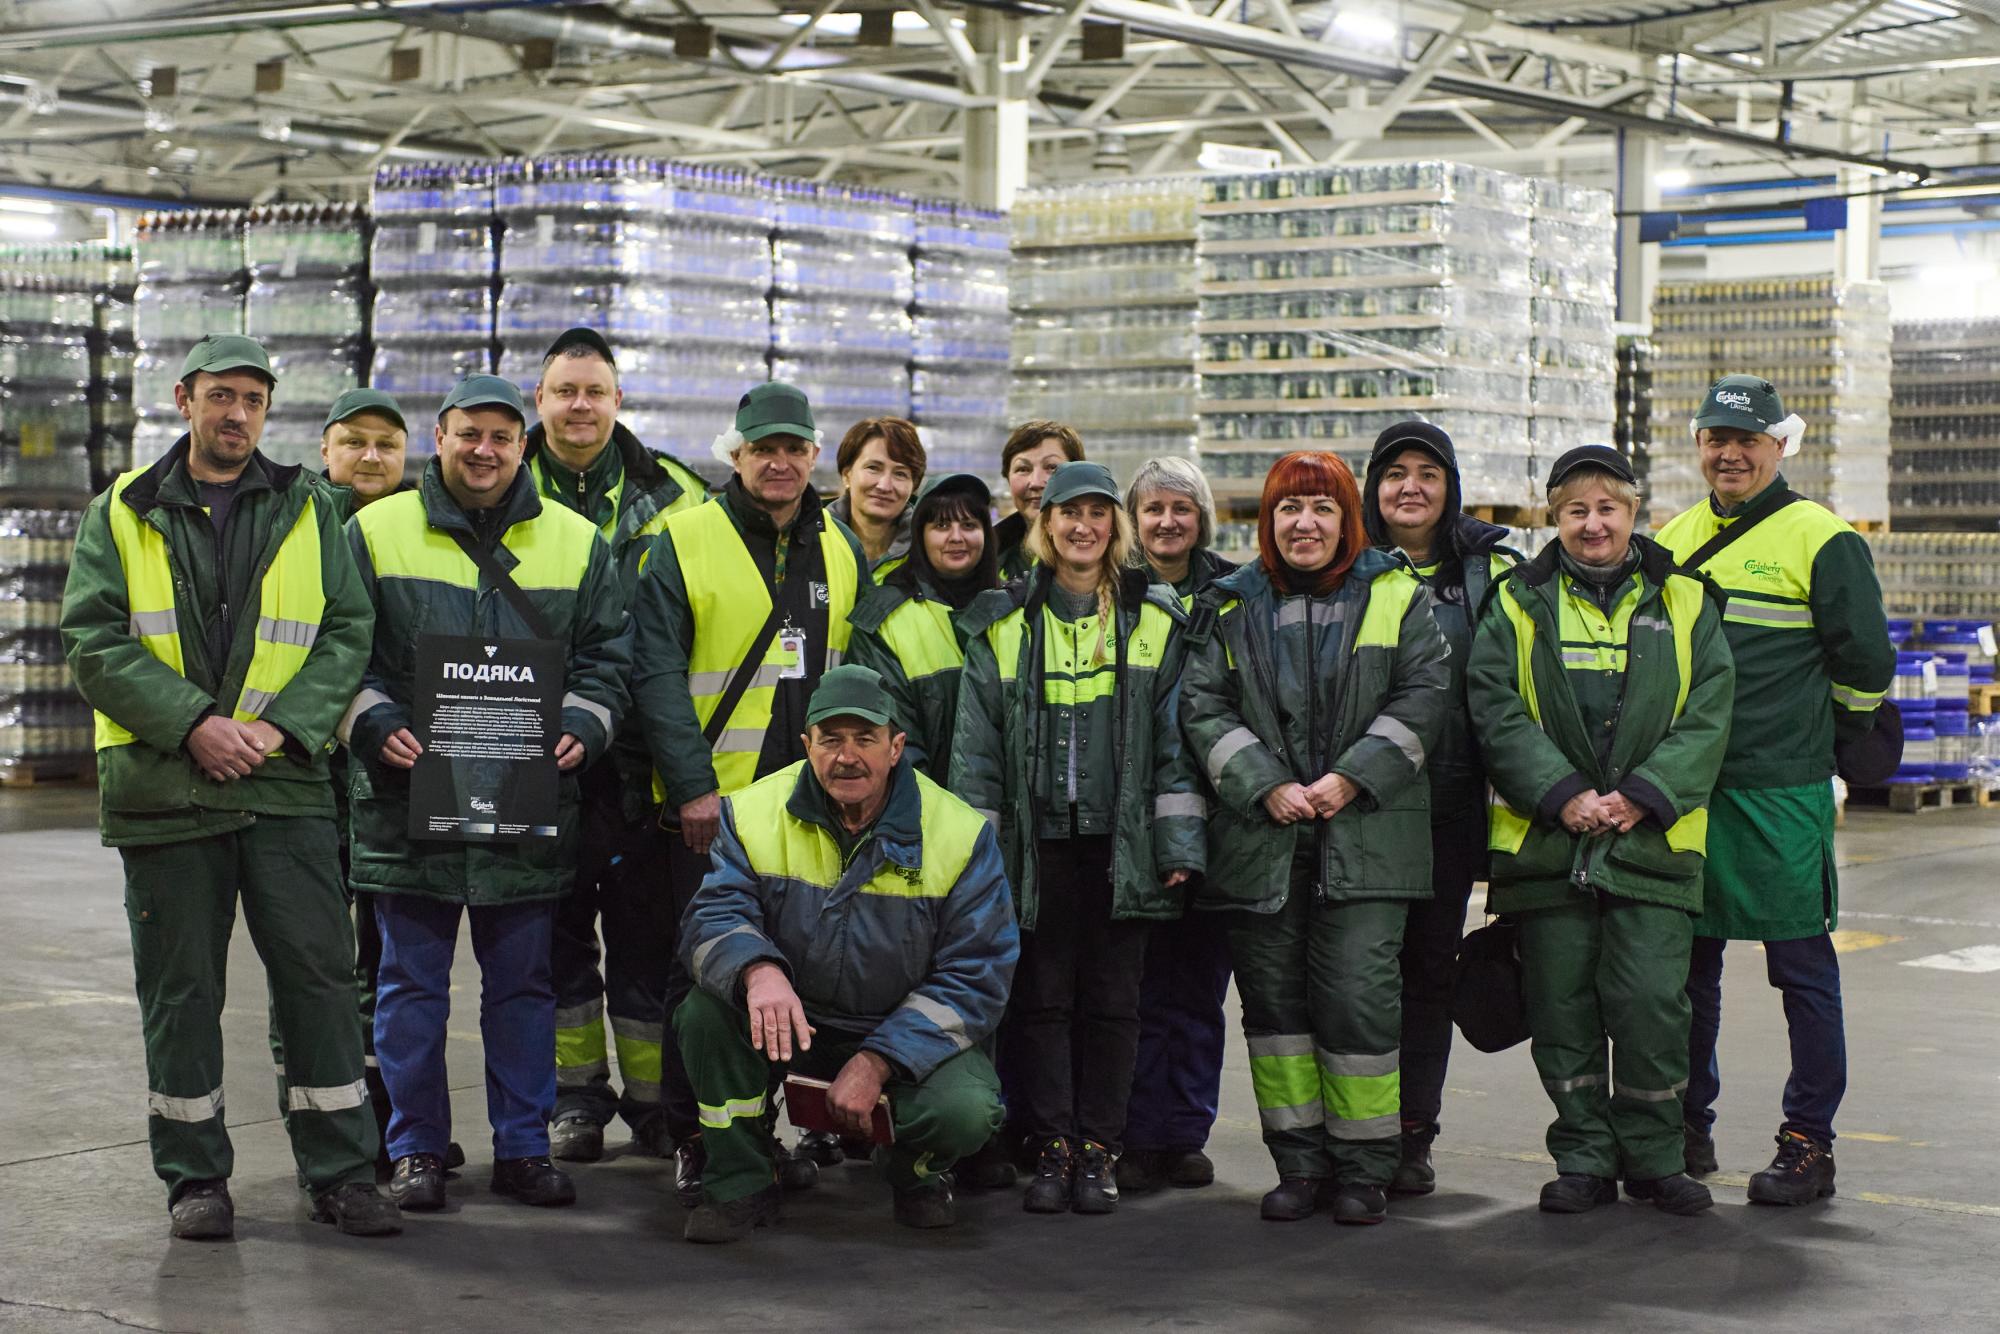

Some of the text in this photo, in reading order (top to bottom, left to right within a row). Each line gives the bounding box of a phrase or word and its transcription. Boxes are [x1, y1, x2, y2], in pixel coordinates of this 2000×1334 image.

[1716, 391, 1751, 405] Carlsberg
[1730, 403, 1754, 413] Ukraine
[1744, 559, 1781, 576] Carlsberg
[443, 662, 535, 682] ПОДЯКА
